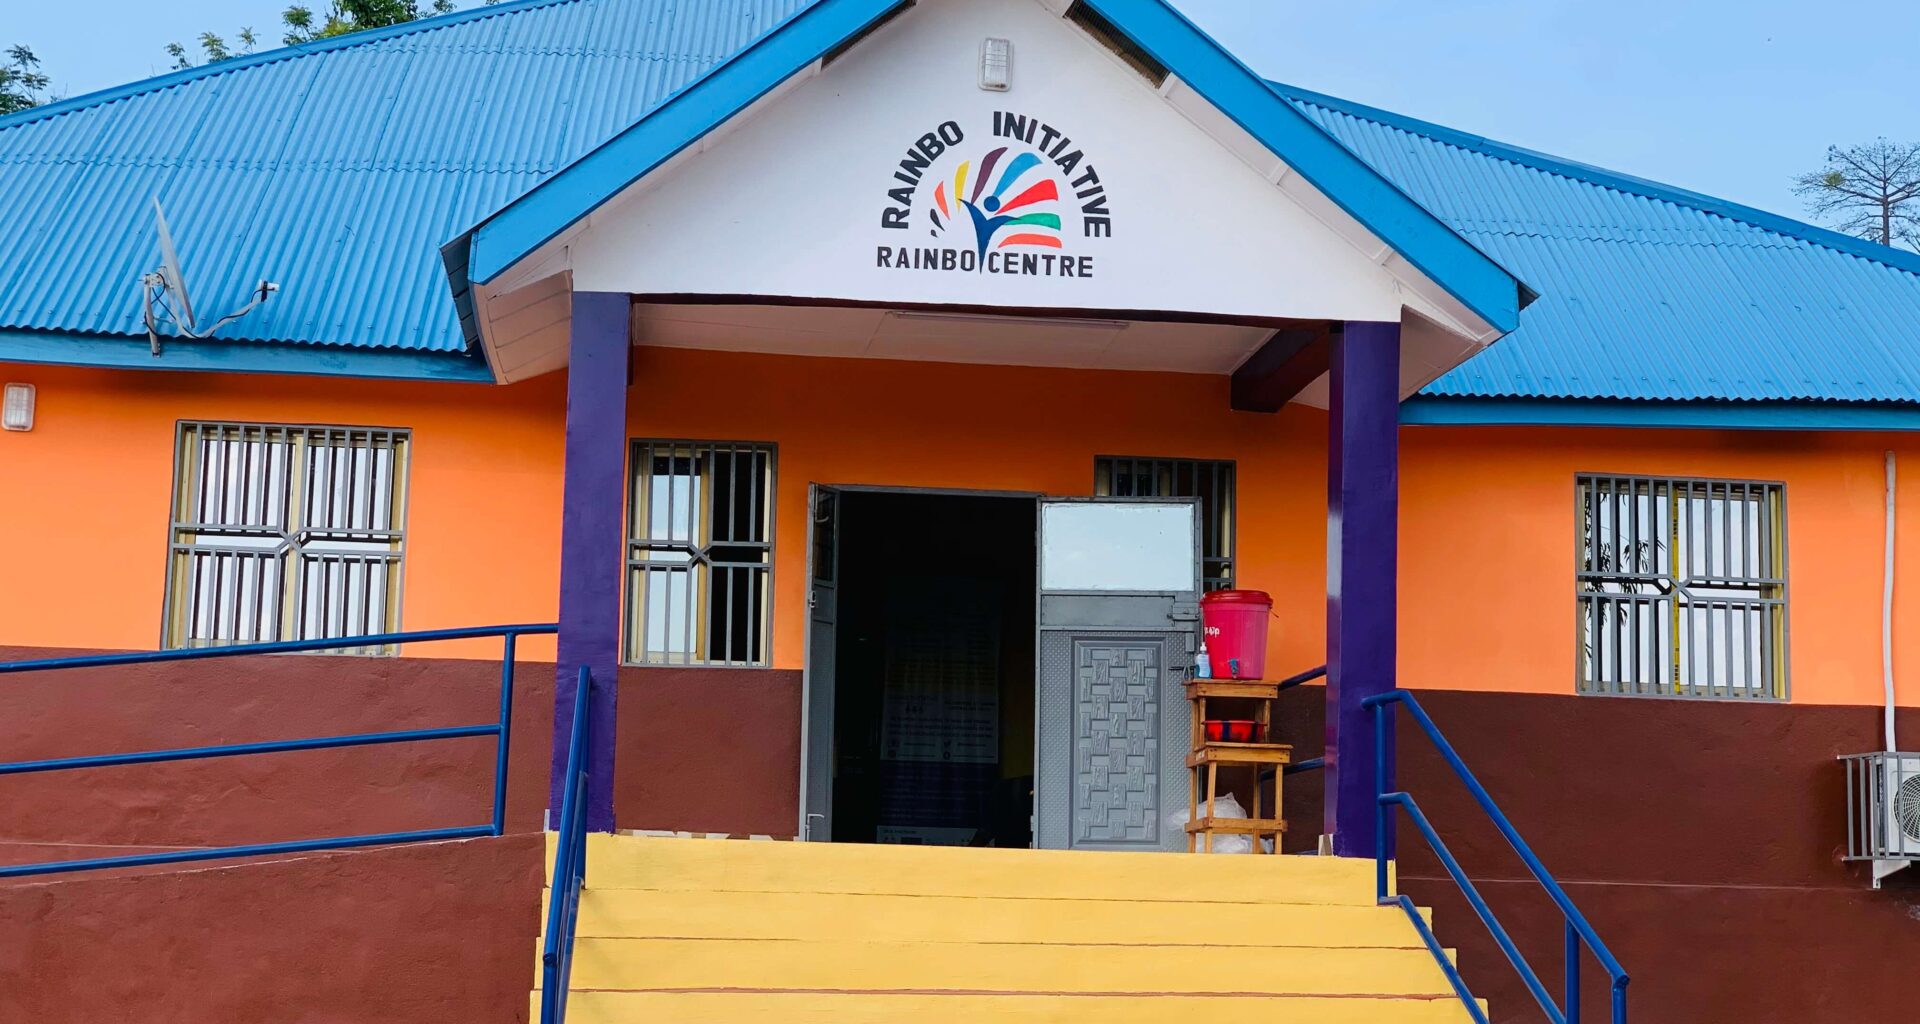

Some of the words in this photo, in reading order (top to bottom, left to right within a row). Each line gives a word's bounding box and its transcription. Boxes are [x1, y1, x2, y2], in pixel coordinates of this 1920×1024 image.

[881, 120, 964, 229] RAINBO
[993, 111, 1112, 238] INITIATIVE
[876, 246, 976, 272] RAINBO
[988, 251, 1093, 278] CENTRE
